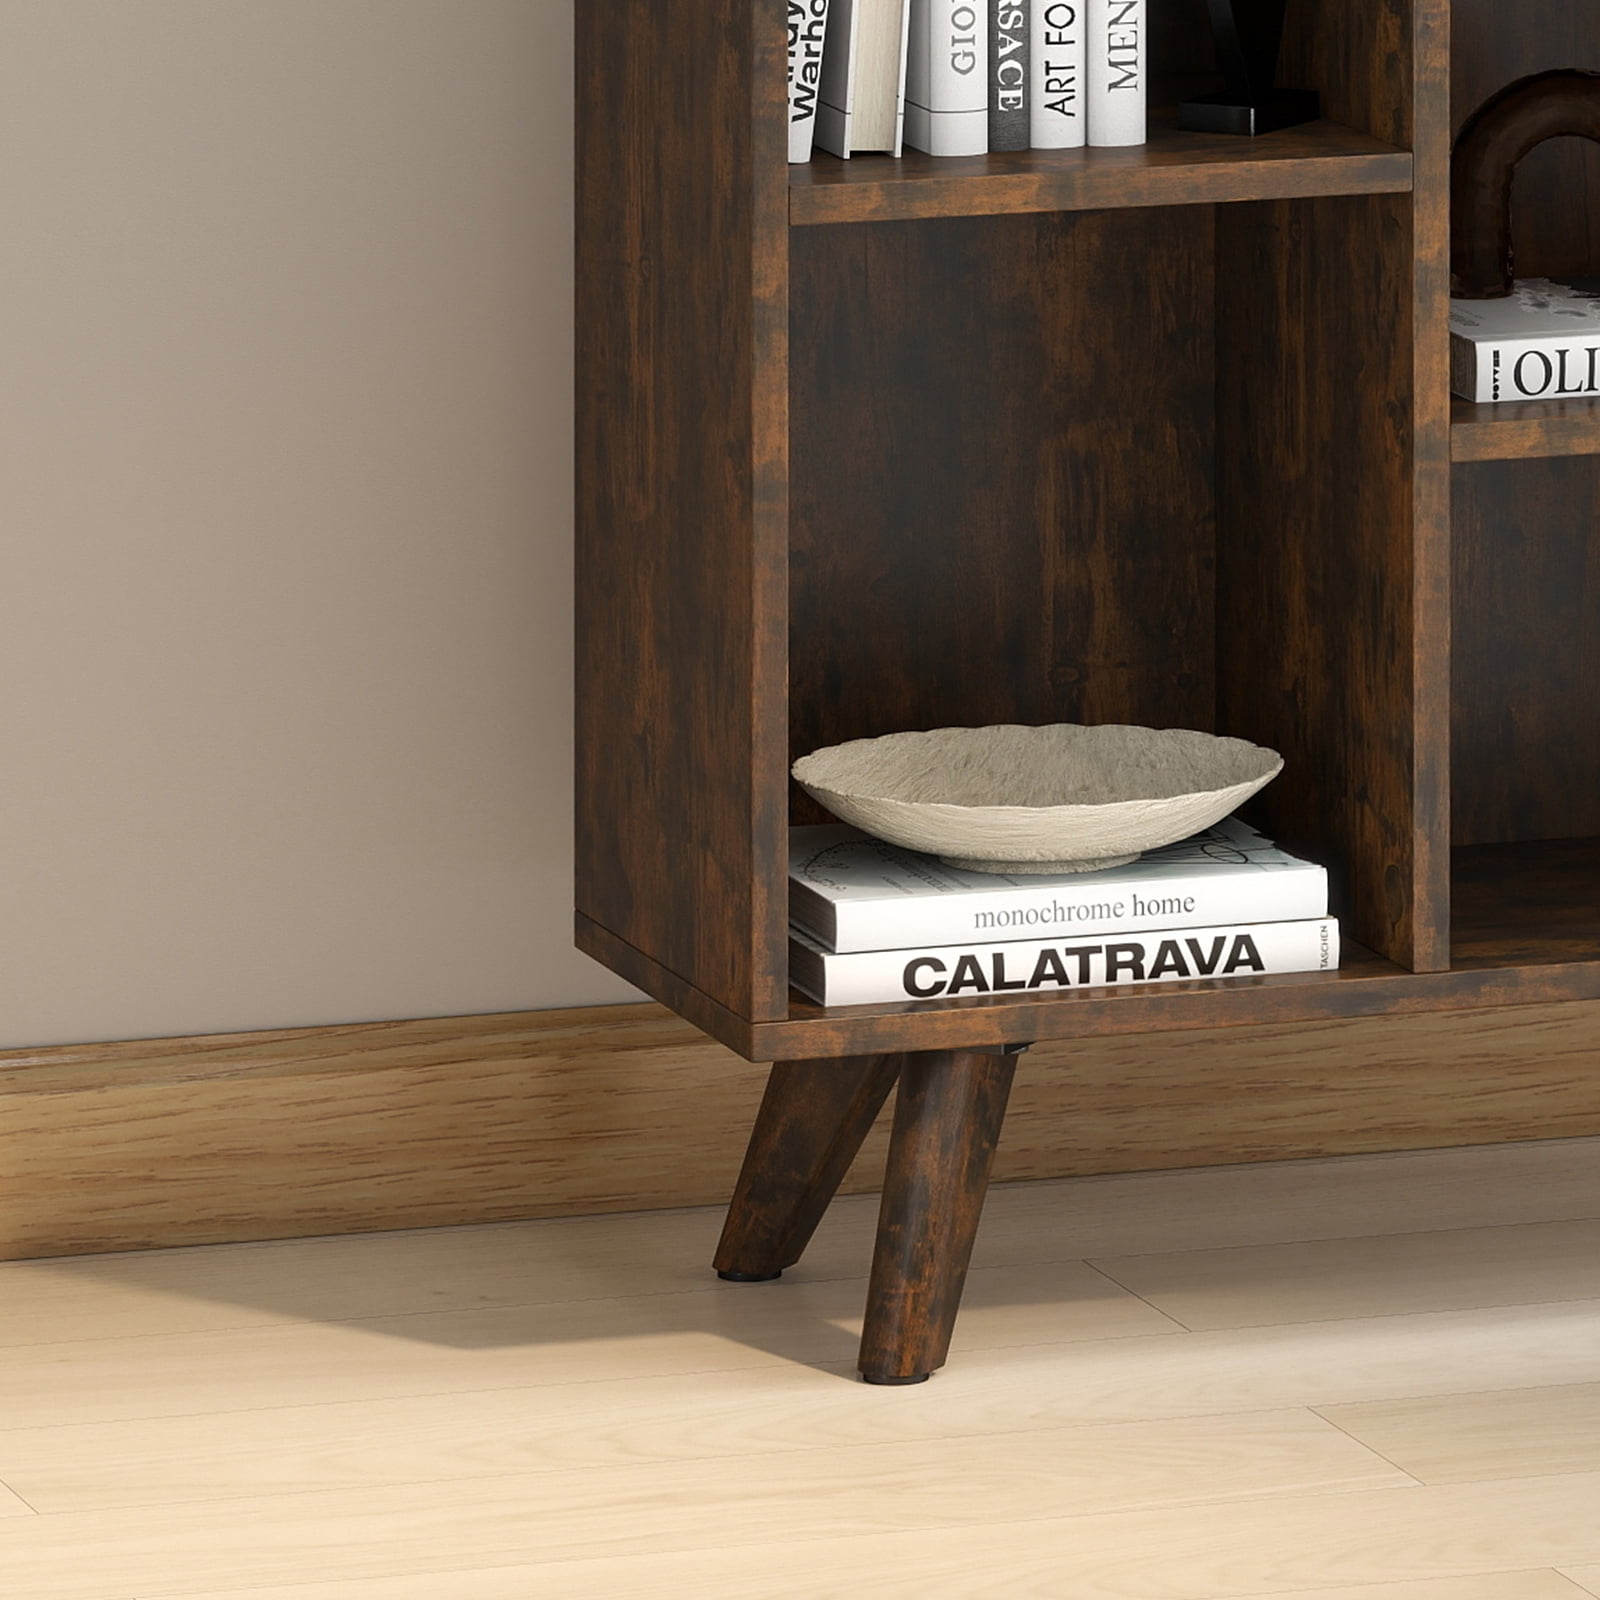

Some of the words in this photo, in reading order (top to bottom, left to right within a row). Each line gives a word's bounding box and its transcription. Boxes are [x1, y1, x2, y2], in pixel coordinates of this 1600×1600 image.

[1044, 61, 1076, 117] ART
[974, 899, 1125, 929] monochrome
[1132, 893, 1195, 917] home
[903, 934, 1265, 998] CALATRAVA
[1320, 926, 1328, 968] TASCHEN
